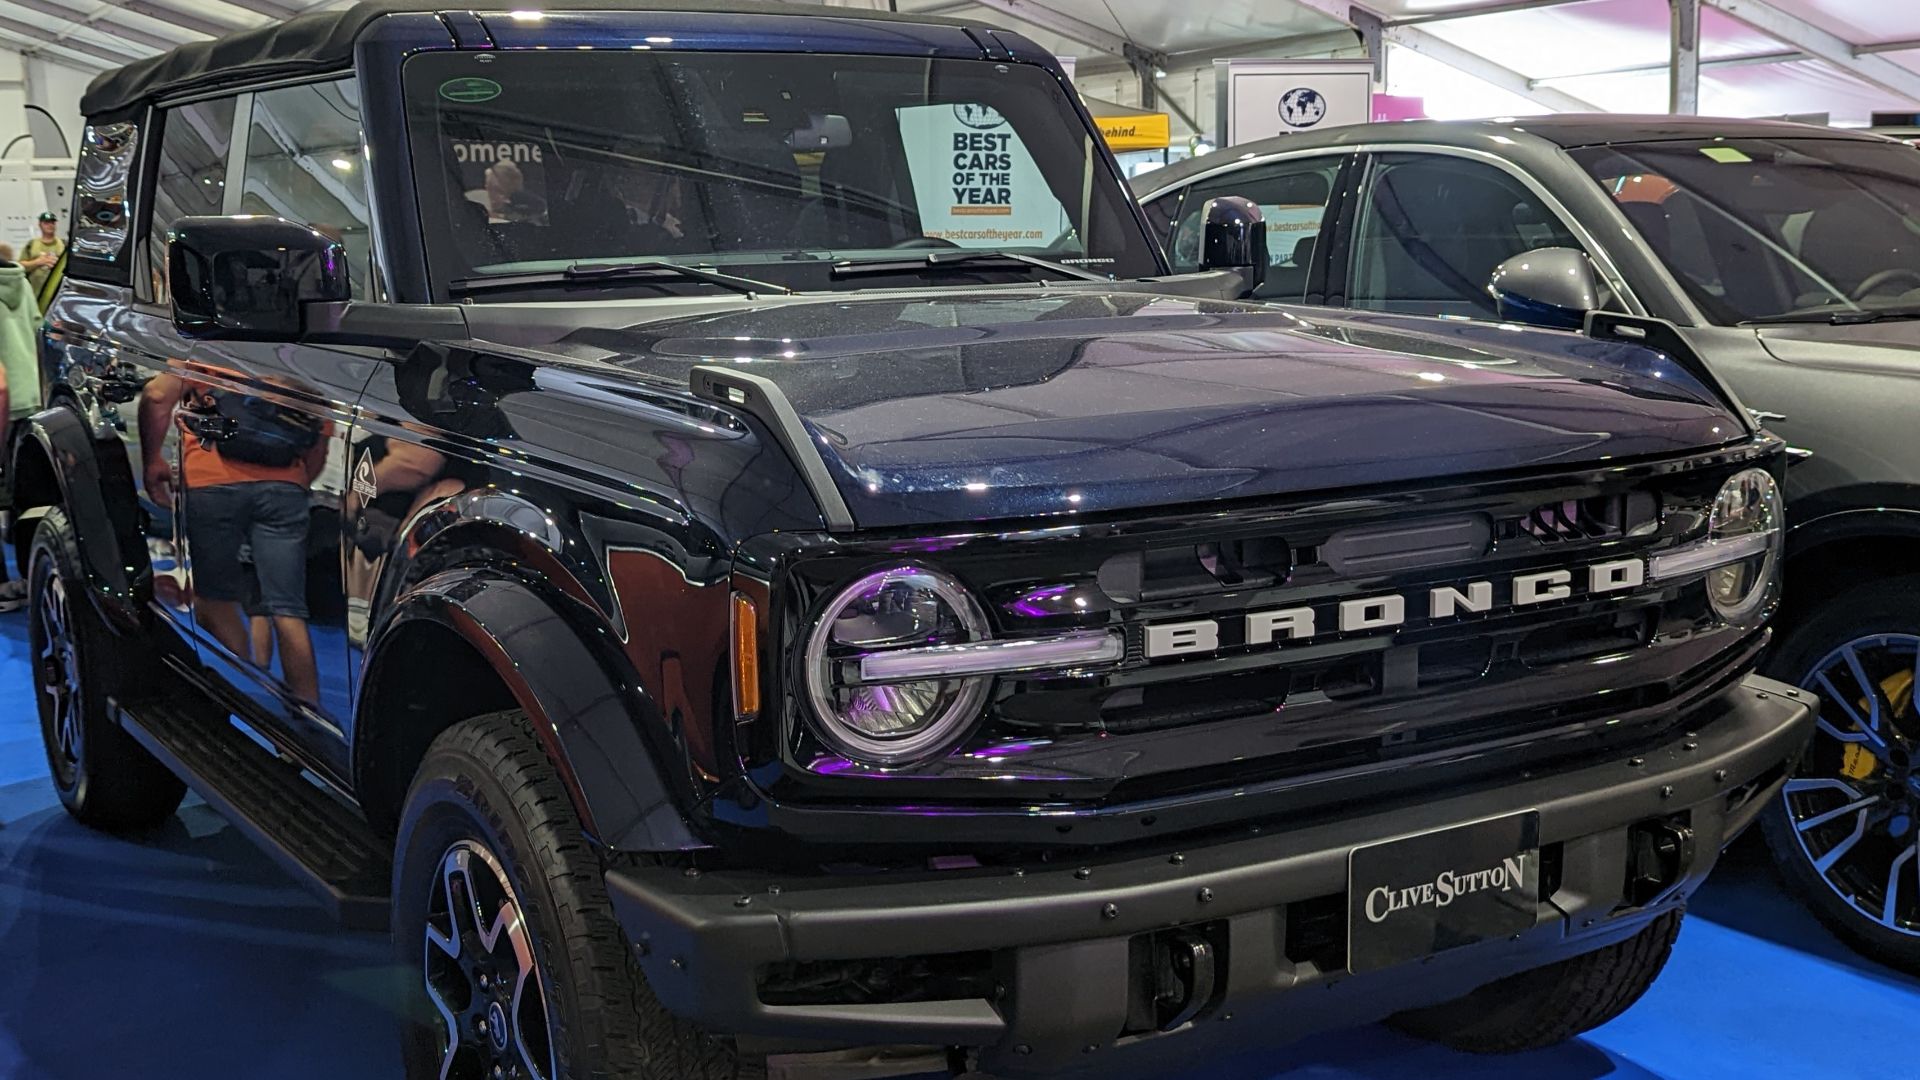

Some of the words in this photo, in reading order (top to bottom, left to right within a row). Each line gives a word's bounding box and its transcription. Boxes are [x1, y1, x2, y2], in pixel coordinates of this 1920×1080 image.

[953, 132, 1011, 151] BEST
[953, 152, 1011, 171] CARS
[952, 172, 975, 186] OF
[979, 172, 1010, 186] THE
[952, 187, 1011, 205] YEAR
[1144, 557, 1644, 657] BRONCO
